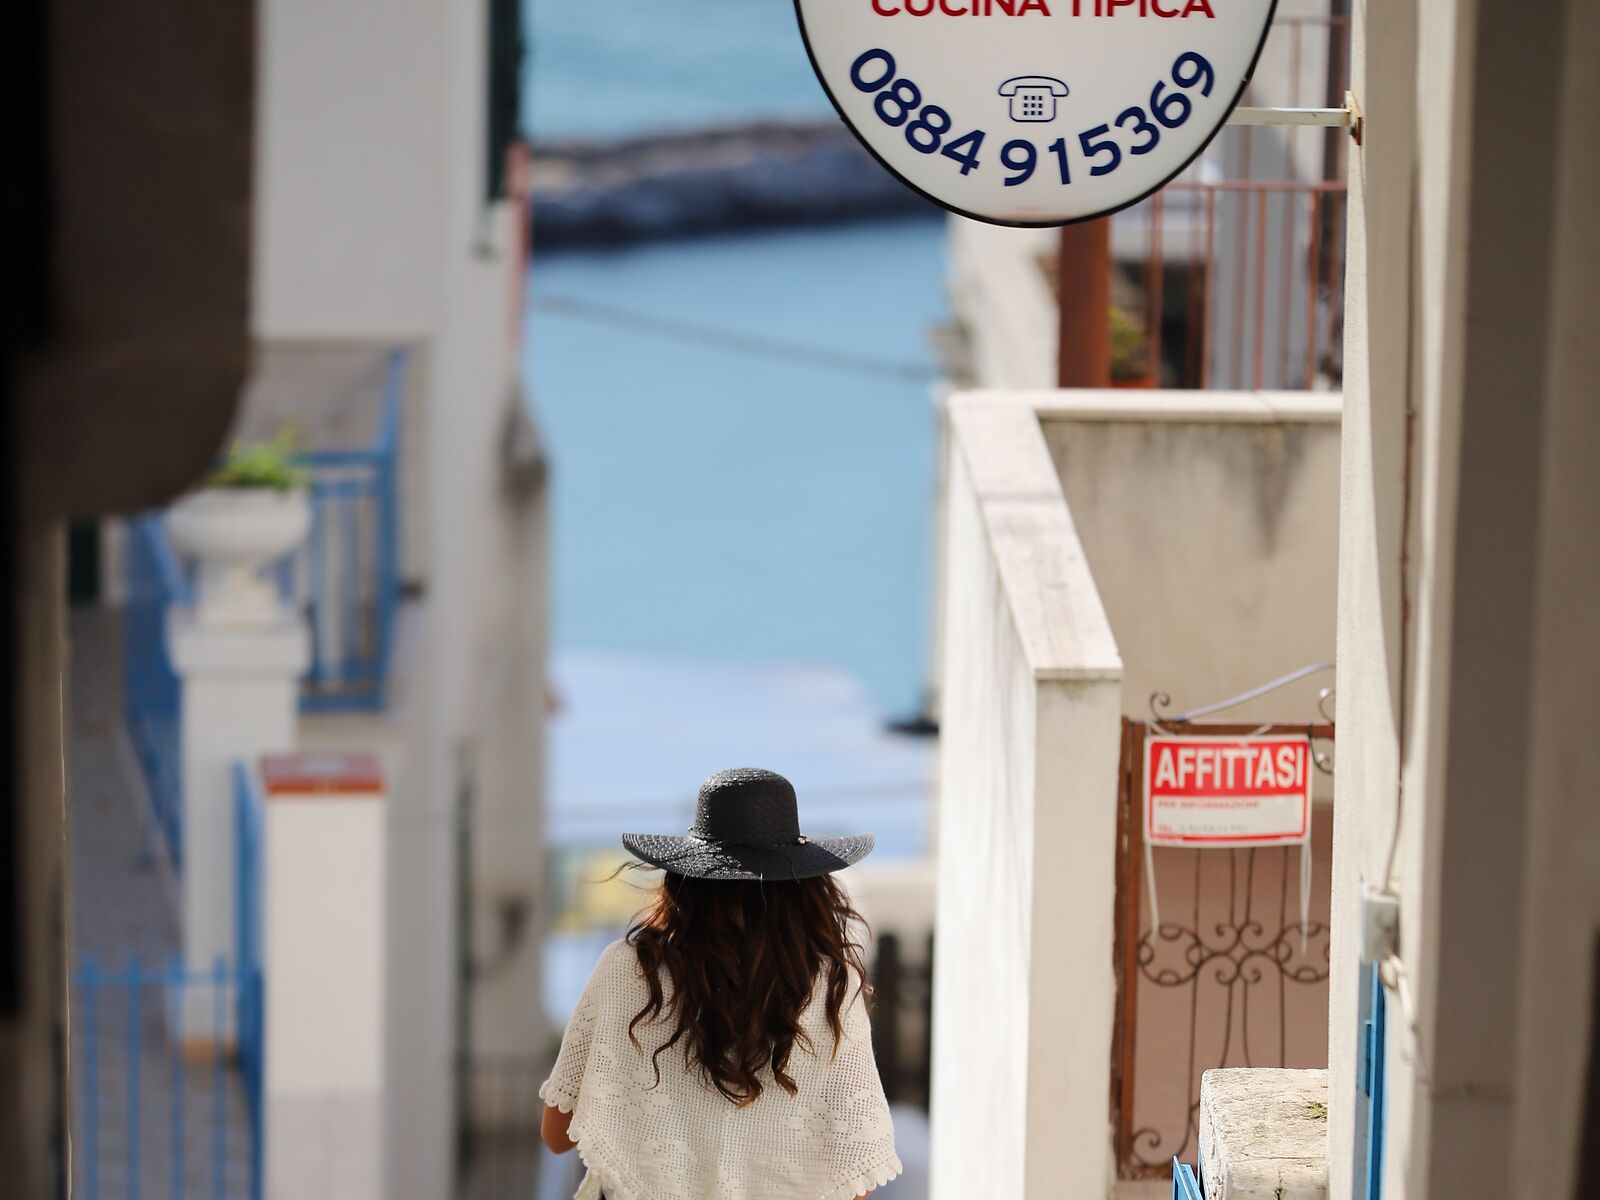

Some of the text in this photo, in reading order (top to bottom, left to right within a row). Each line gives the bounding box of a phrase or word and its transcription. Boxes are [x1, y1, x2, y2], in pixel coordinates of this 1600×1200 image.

[851, 48, 1214, 186] 0884 915369
[1154, 746, 1304, 789] AFFITTASI
